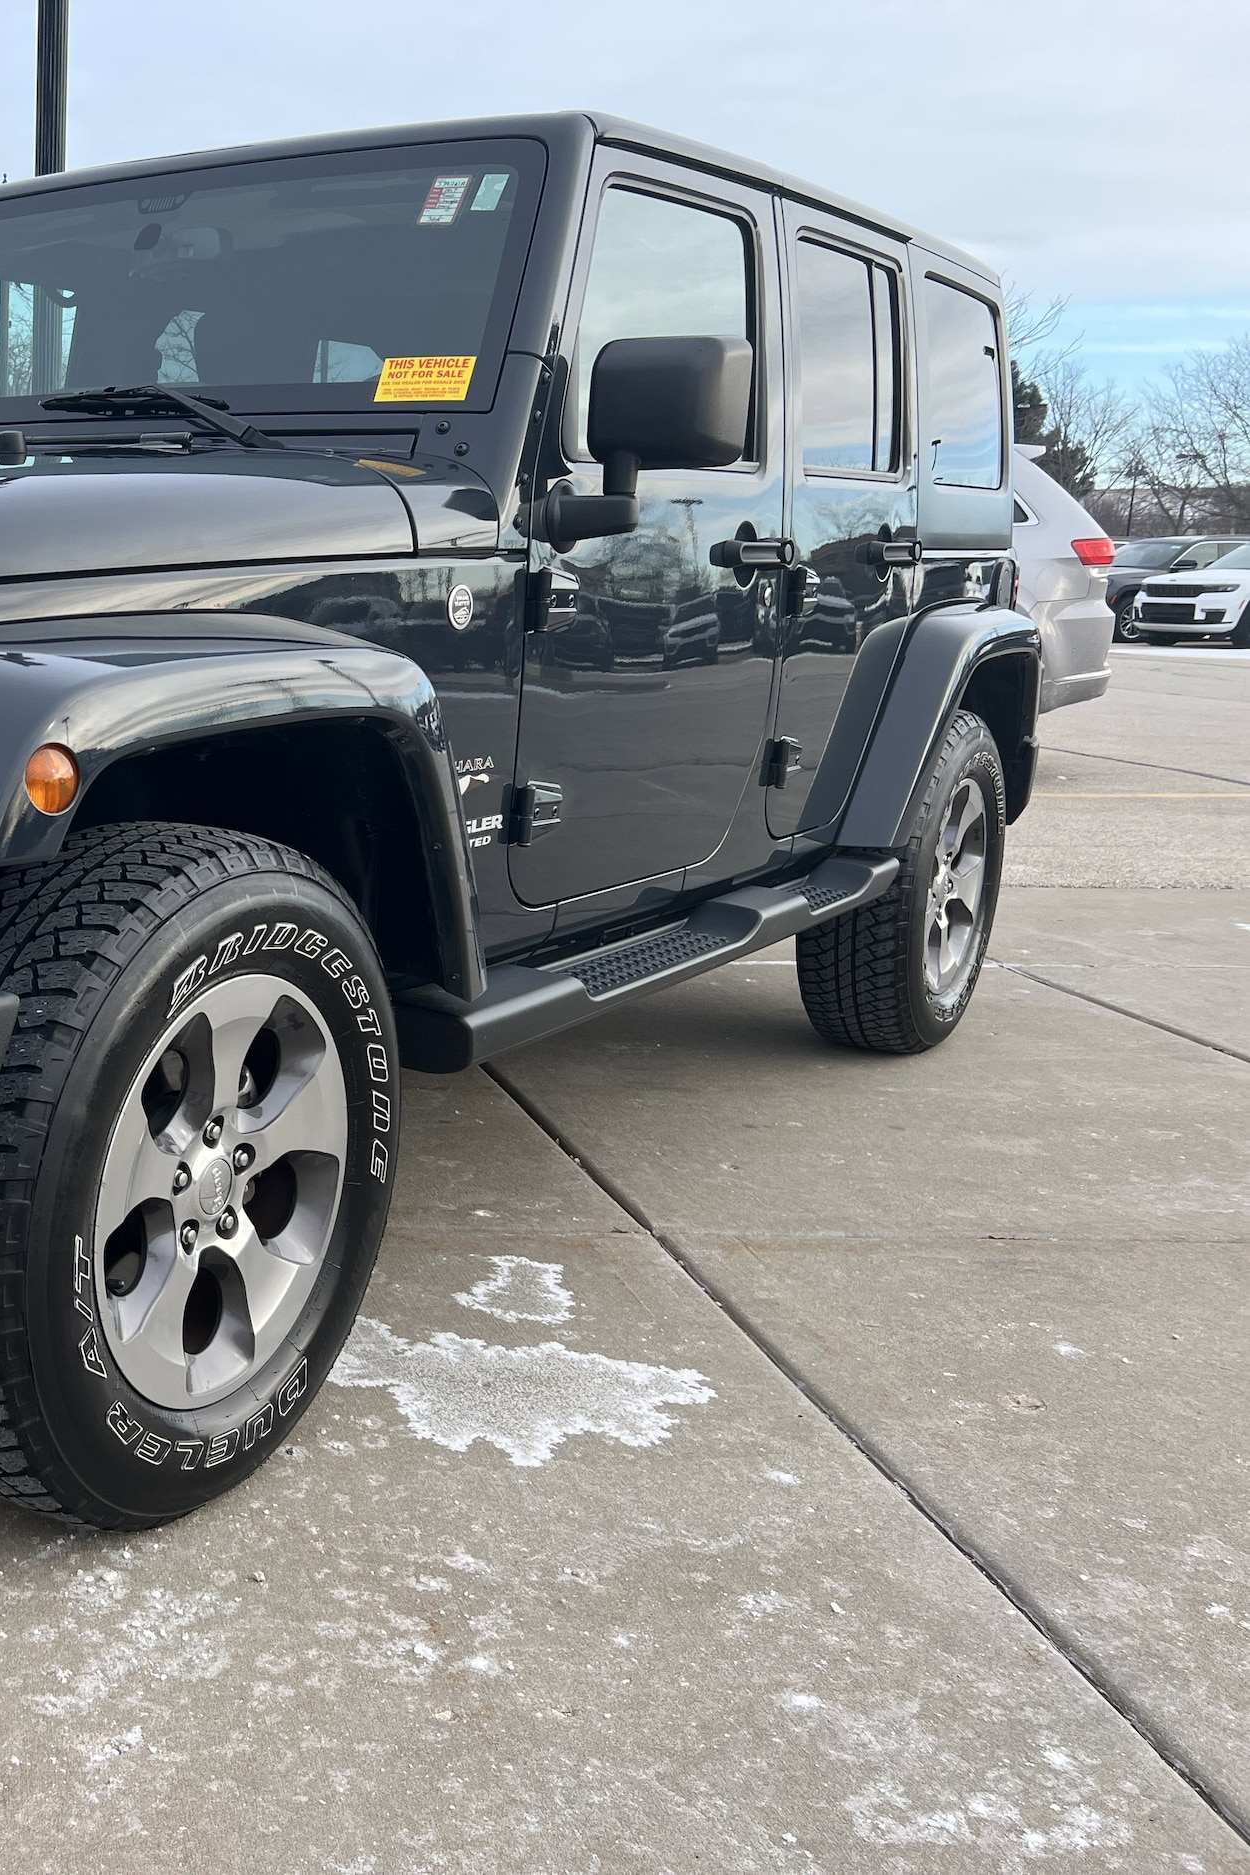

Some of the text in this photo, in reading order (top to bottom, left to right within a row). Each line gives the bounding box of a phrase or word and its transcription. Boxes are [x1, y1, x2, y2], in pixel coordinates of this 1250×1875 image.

[388, 358, 471, 370] THIS VEHICLE
[387, 370, 465, 379] NOT FOR SALE
[455, 756, 494, 773] HARA
[470, 835, 491, 848] TED
[167, 923, 390, 1183] BRIDGESTONE
[106, 1356, 308, 1470] DUELER
